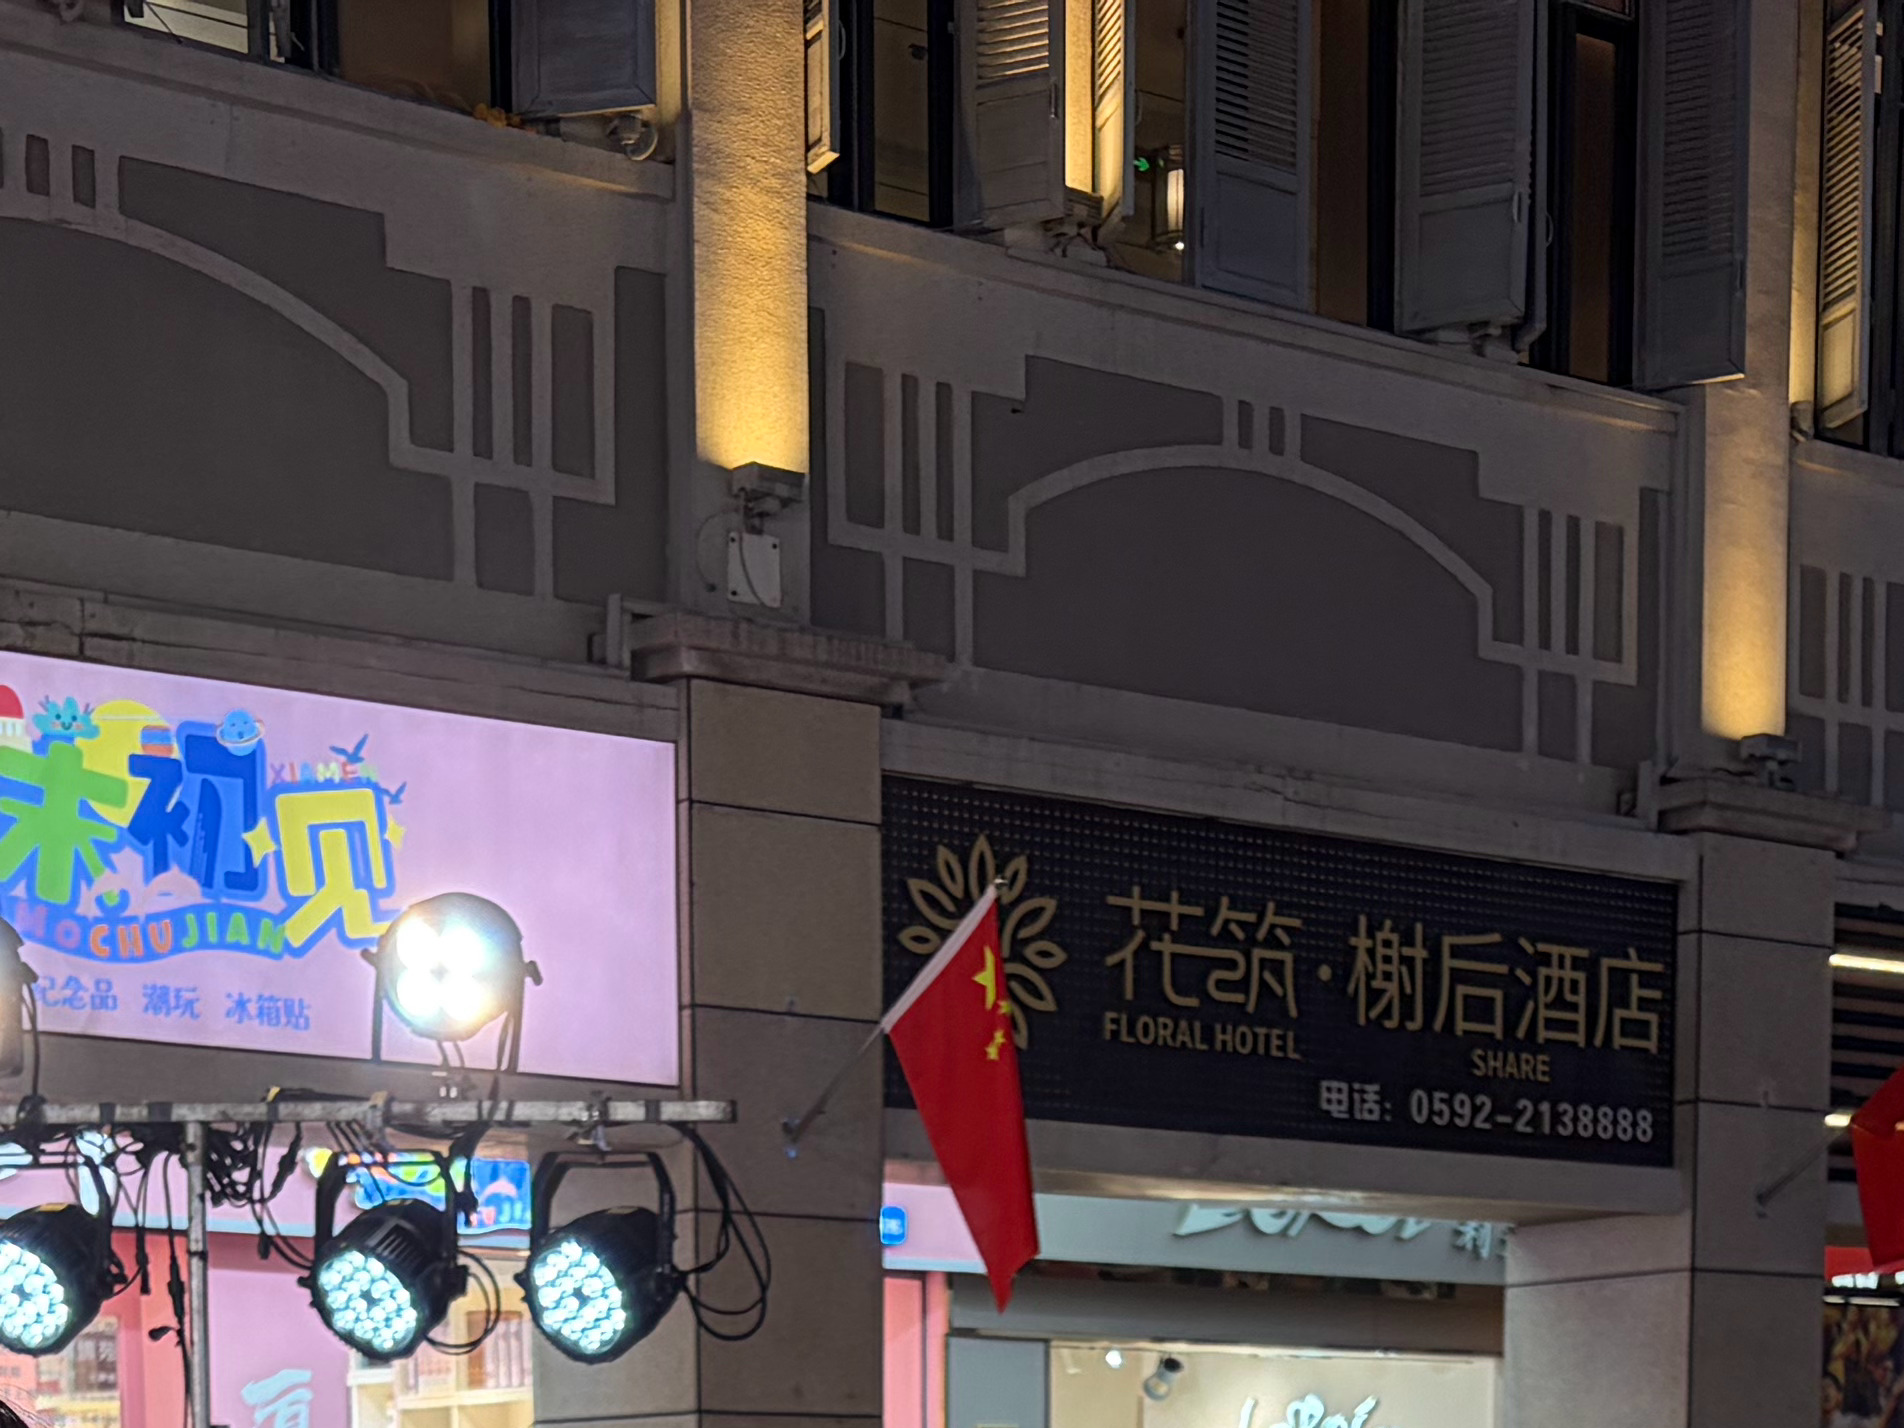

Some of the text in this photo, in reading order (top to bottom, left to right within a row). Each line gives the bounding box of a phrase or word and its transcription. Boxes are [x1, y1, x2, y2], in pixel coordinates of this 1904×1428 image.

[142, 982, 202, 1020] 潮玩
[225, 991, 312, 1033] 冰箱贴
[1104, 1011, 1303, 1062] FLORAL HOTEL
[1471, 1047, 1552, 1084] SHARE
[1410, 1088, 1654, 1144] 0592-2138888
